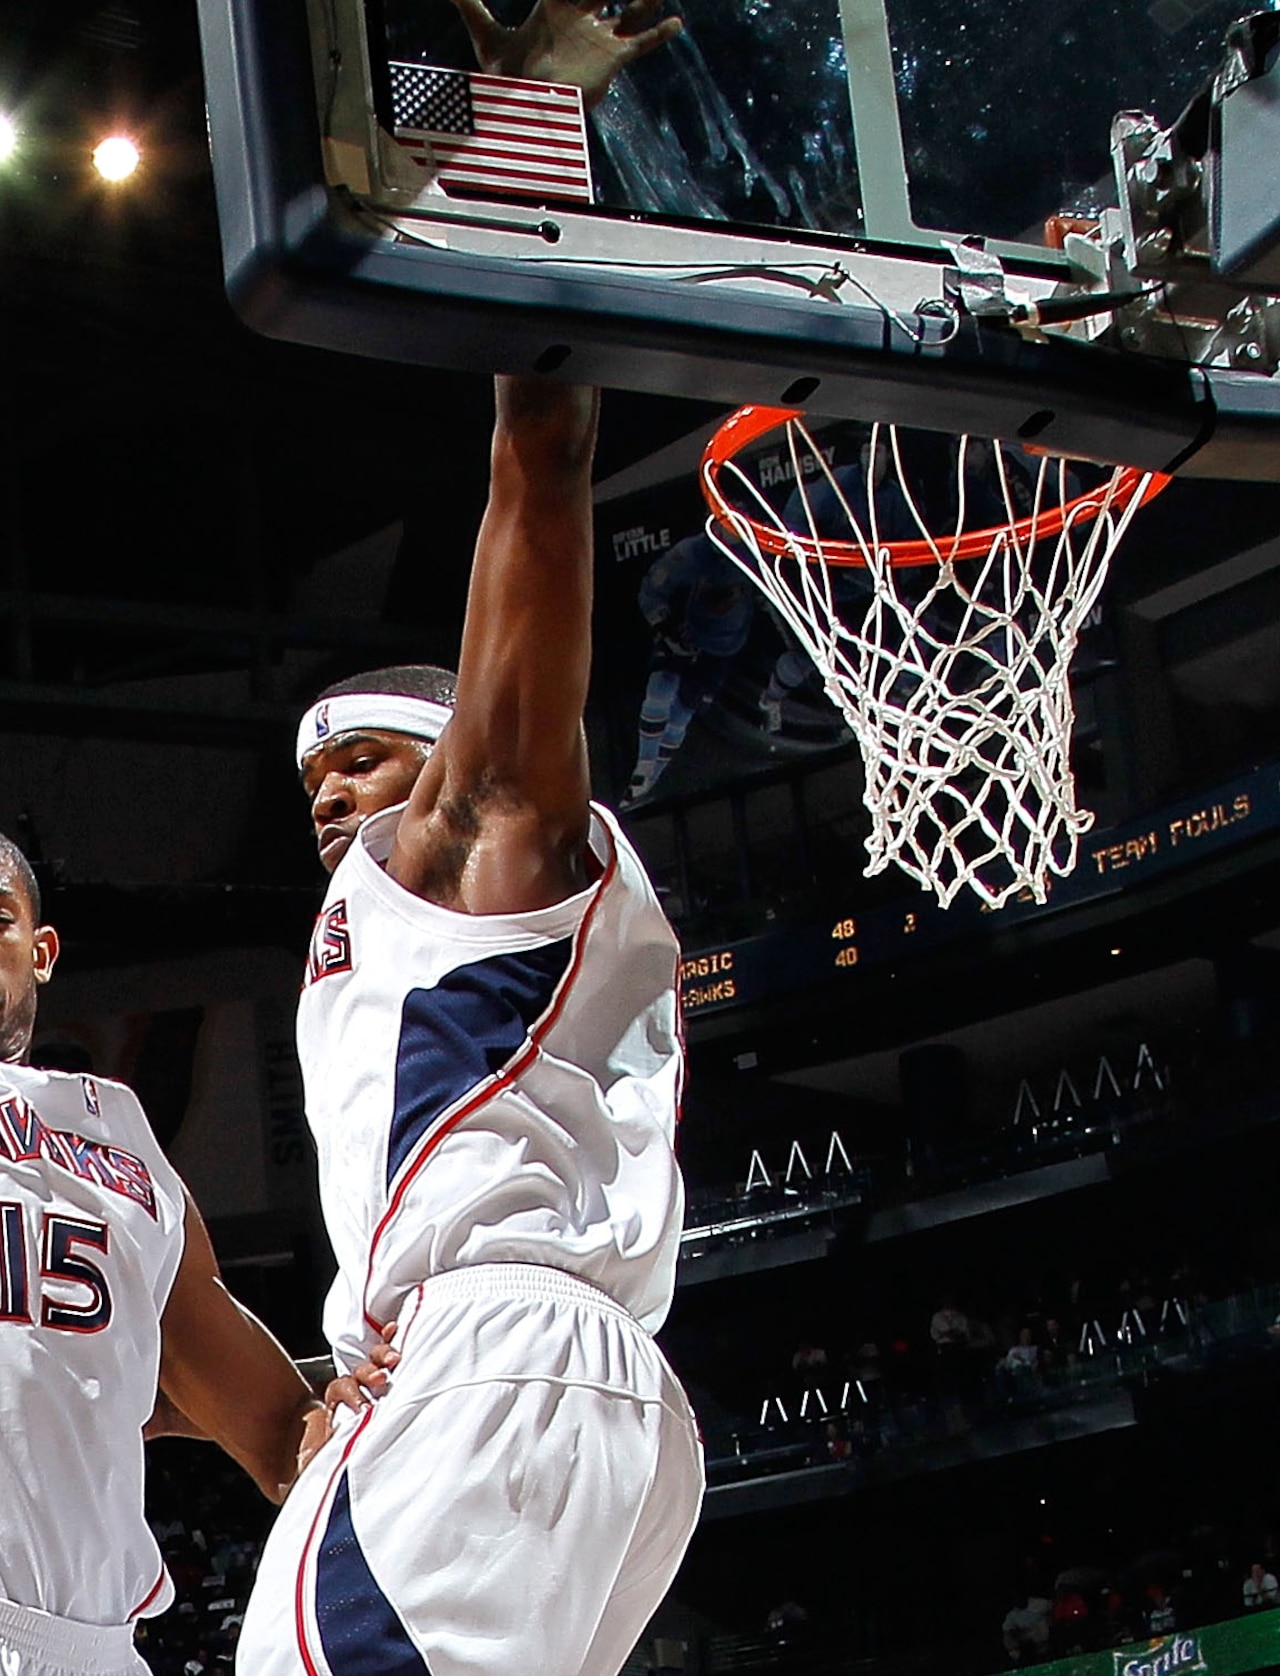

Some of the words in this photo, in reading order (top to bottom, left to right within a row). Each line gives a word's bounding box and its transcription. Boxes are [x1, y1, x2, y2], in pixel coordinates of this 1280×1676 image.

[613, 528, 670, 563] LITTLE
[1092, 831, 1159, 874] TEAM
[1170, 794, 1251, 846] FOULS
[830, 915, 858, 940] 48
[833, 944, 861, 968] 40
